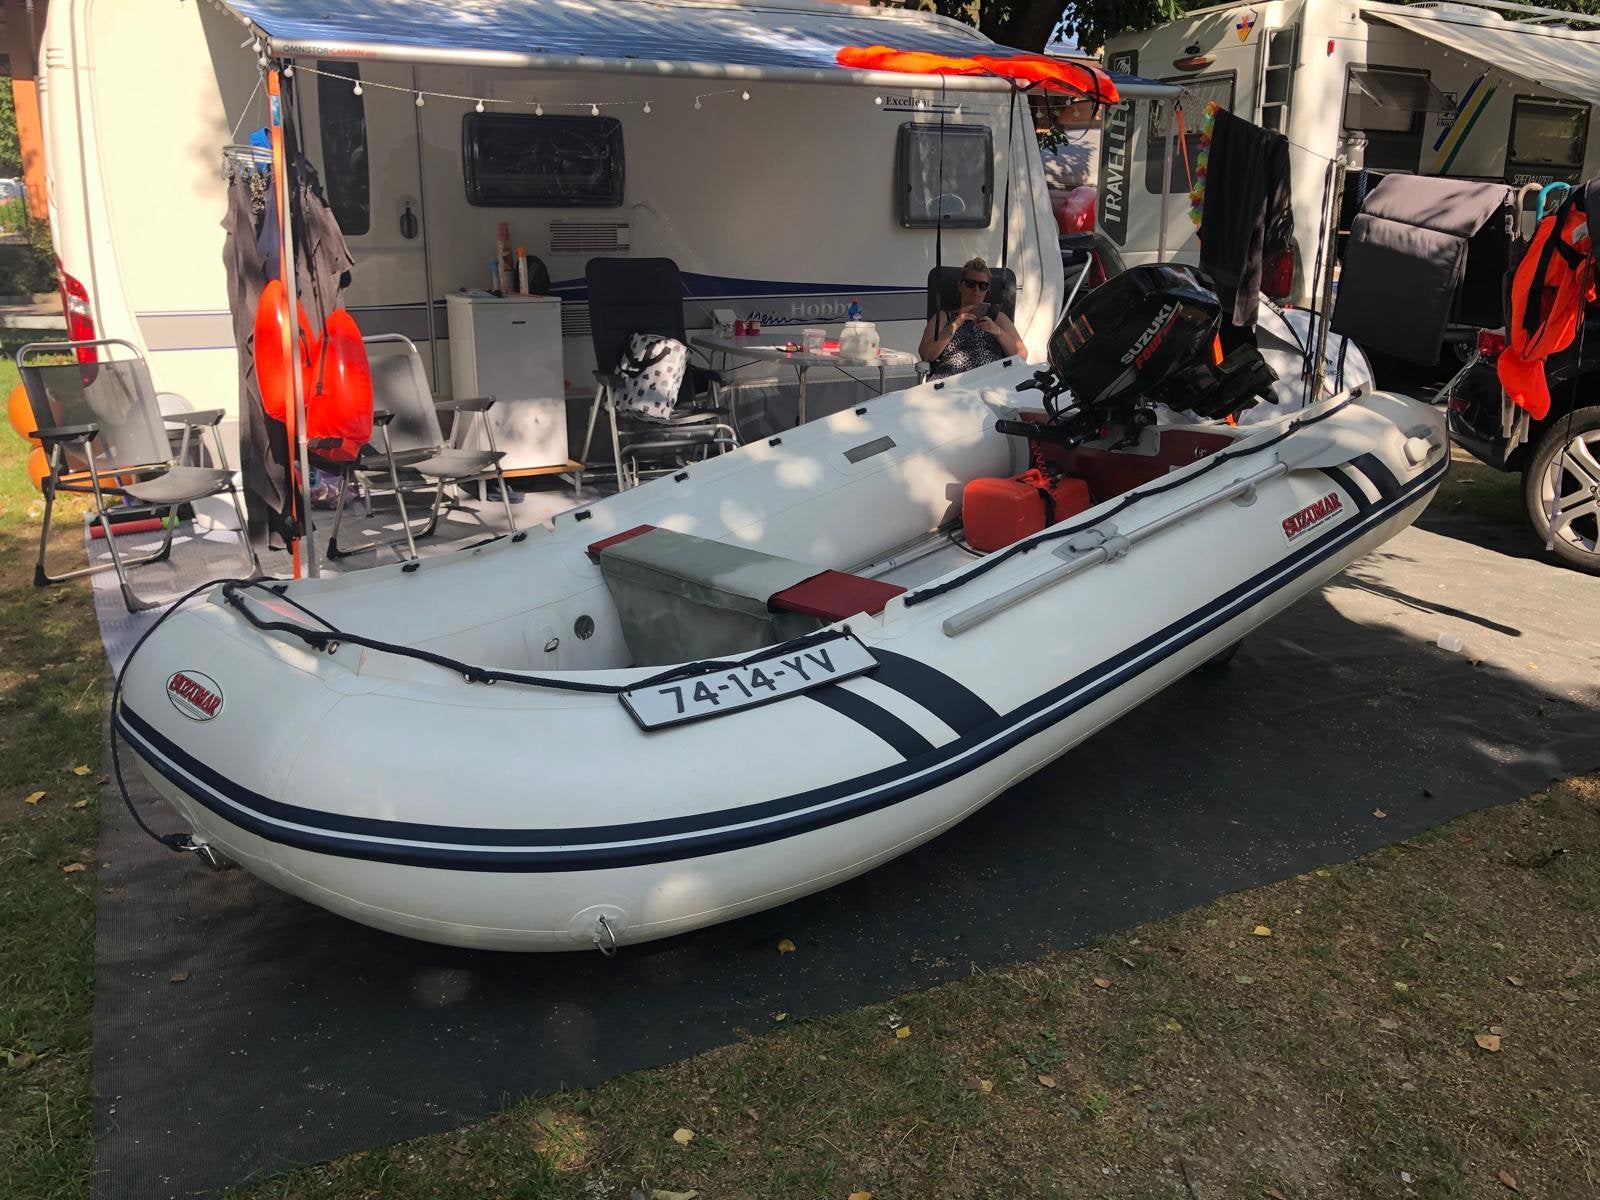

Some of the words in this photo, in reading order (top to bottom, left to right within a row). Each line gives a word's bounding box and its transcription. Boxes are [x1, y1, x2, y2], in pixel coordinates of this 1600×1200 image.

[1120, 304, 1172, 364] SUZUKI
[1282, 492, 1343, 539] SUZUMAR
[658, 648, 836, 714] 74-14-YV
